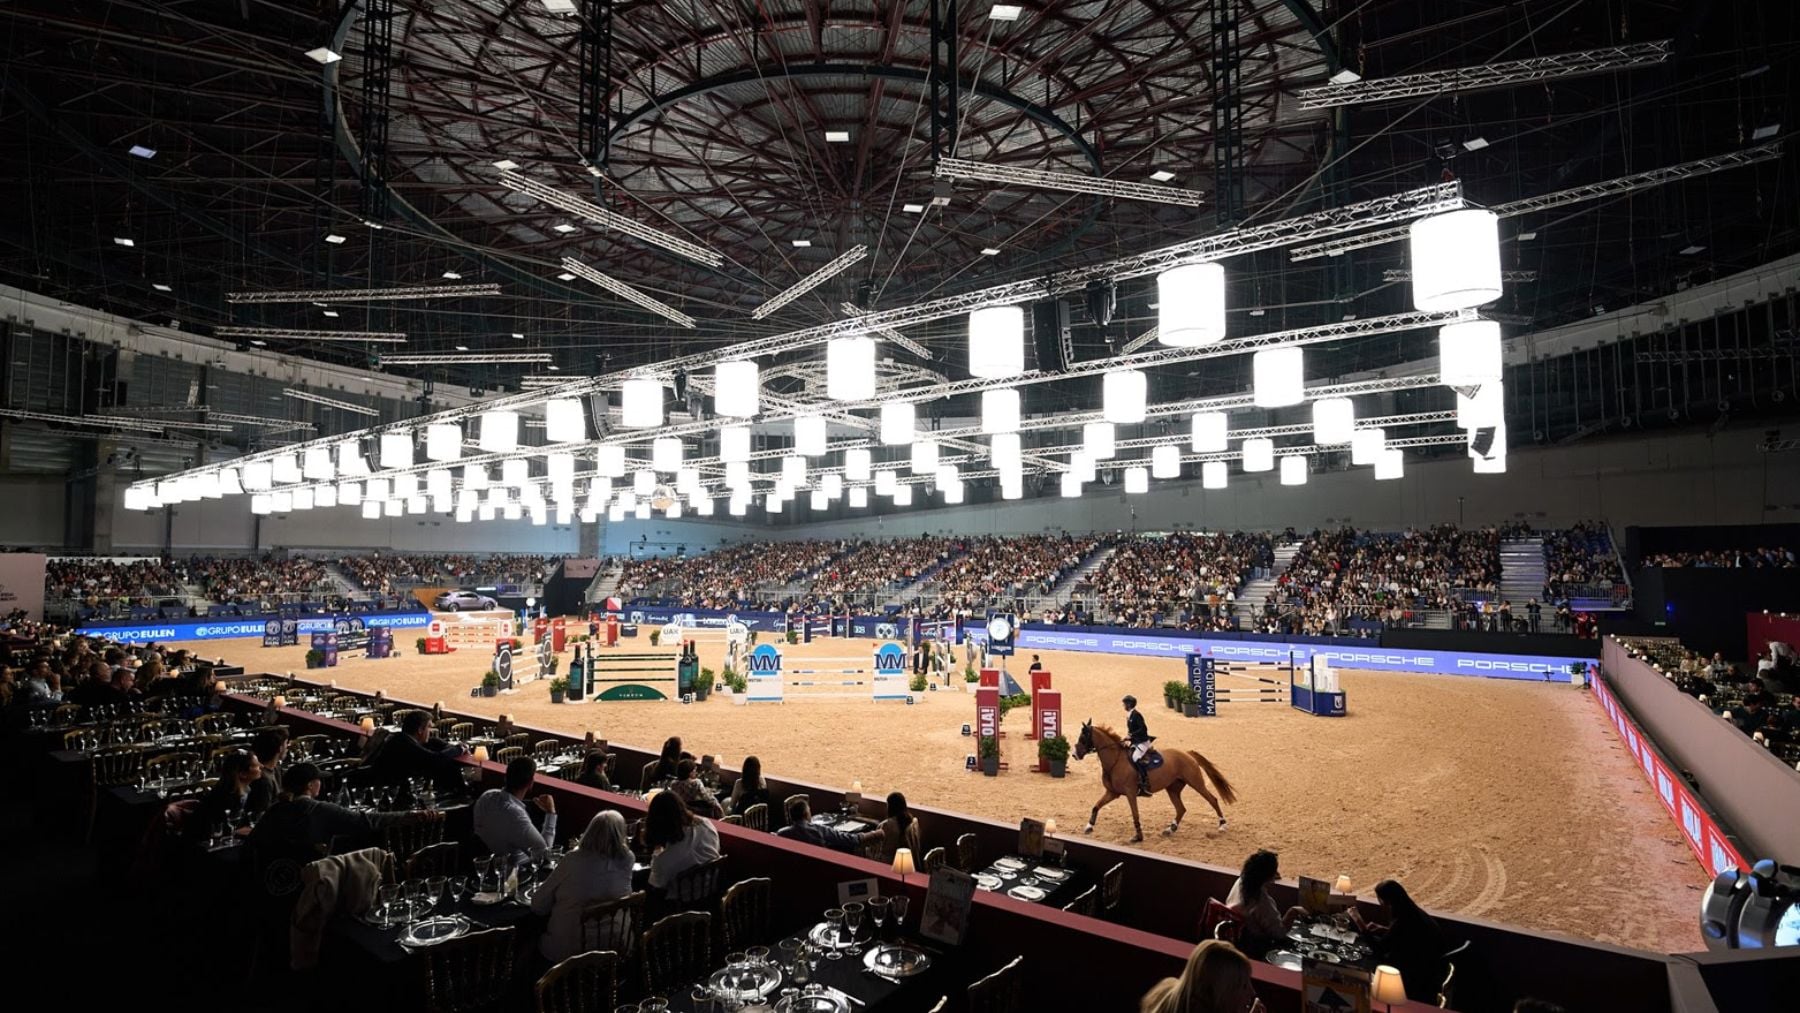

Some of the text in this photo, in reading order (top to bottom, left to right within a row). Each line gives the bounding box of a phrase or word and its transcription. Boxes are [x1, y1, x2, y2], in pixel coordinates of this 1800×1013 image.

[403, 616, 427, 625] EULEN
[103, 628, 175, 641] GRUPO EULEN
[207, 625, 241, 635] GRUPO
[1026, 635, 1098, 647] PORSCHE
[1112, 640, 1195, 652] PORSCHE
[1211, 646, 1305, 659] PORSCHE
[1325, 651, 1434, 666] PORSCHE
[748, 654, 782, 671] MM
[874, 653, 907, 670] MM
[1205, 672, 1215, 715] MADRID
[981, 708, 995, 736] OLA!
[1043, 711, 1057, 739] OLA!
